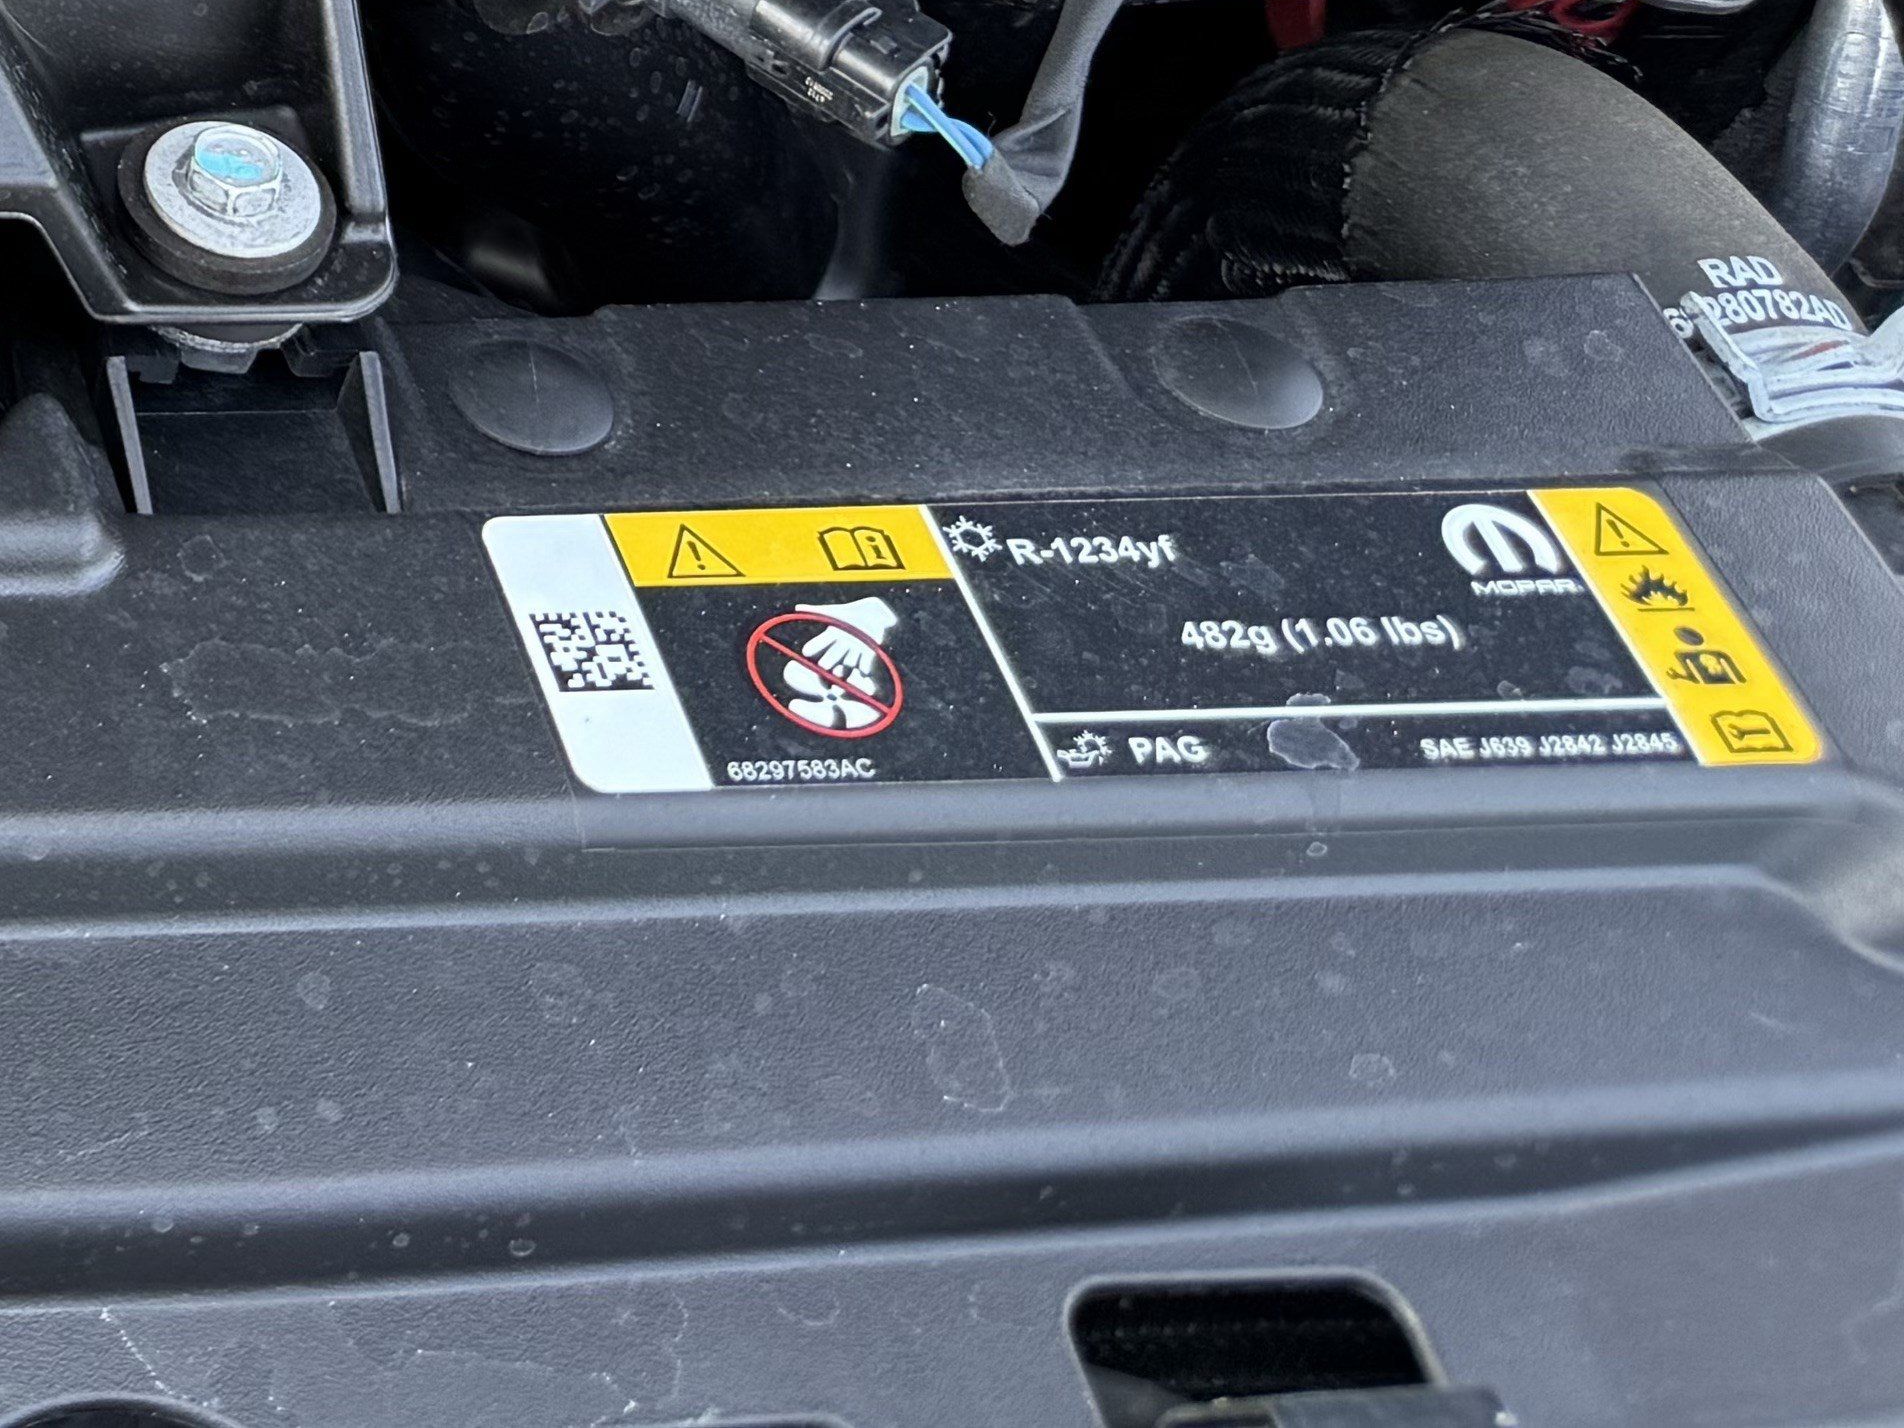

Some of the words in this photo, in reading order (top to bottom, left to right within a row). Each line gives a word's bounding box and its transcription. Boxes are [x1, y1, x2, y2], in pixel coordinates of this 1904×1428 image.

[1697, 255, 1784, 289] RAD
[1663, 288, 1853, 339] 6280782AD
[1006, 532, 1176, 568] R-1234yf
[1470, 578, 1578, 596] MOPAR
[1180, 619, 1276, 656] 482g
[1283, 617, 1376, 654] (1.06
[1384, 613, 1464, 651] lbs)
[1127, 735, 1209, 765] PAG
[1420, 736, 1475, 761] SAE
[1479, 735, 1533, 759] J639
[1539, 733, 1607, 757] J2842
[1612, 731, 1680, 756] J2845
[726, 757, 877, 782] 68297583AC
